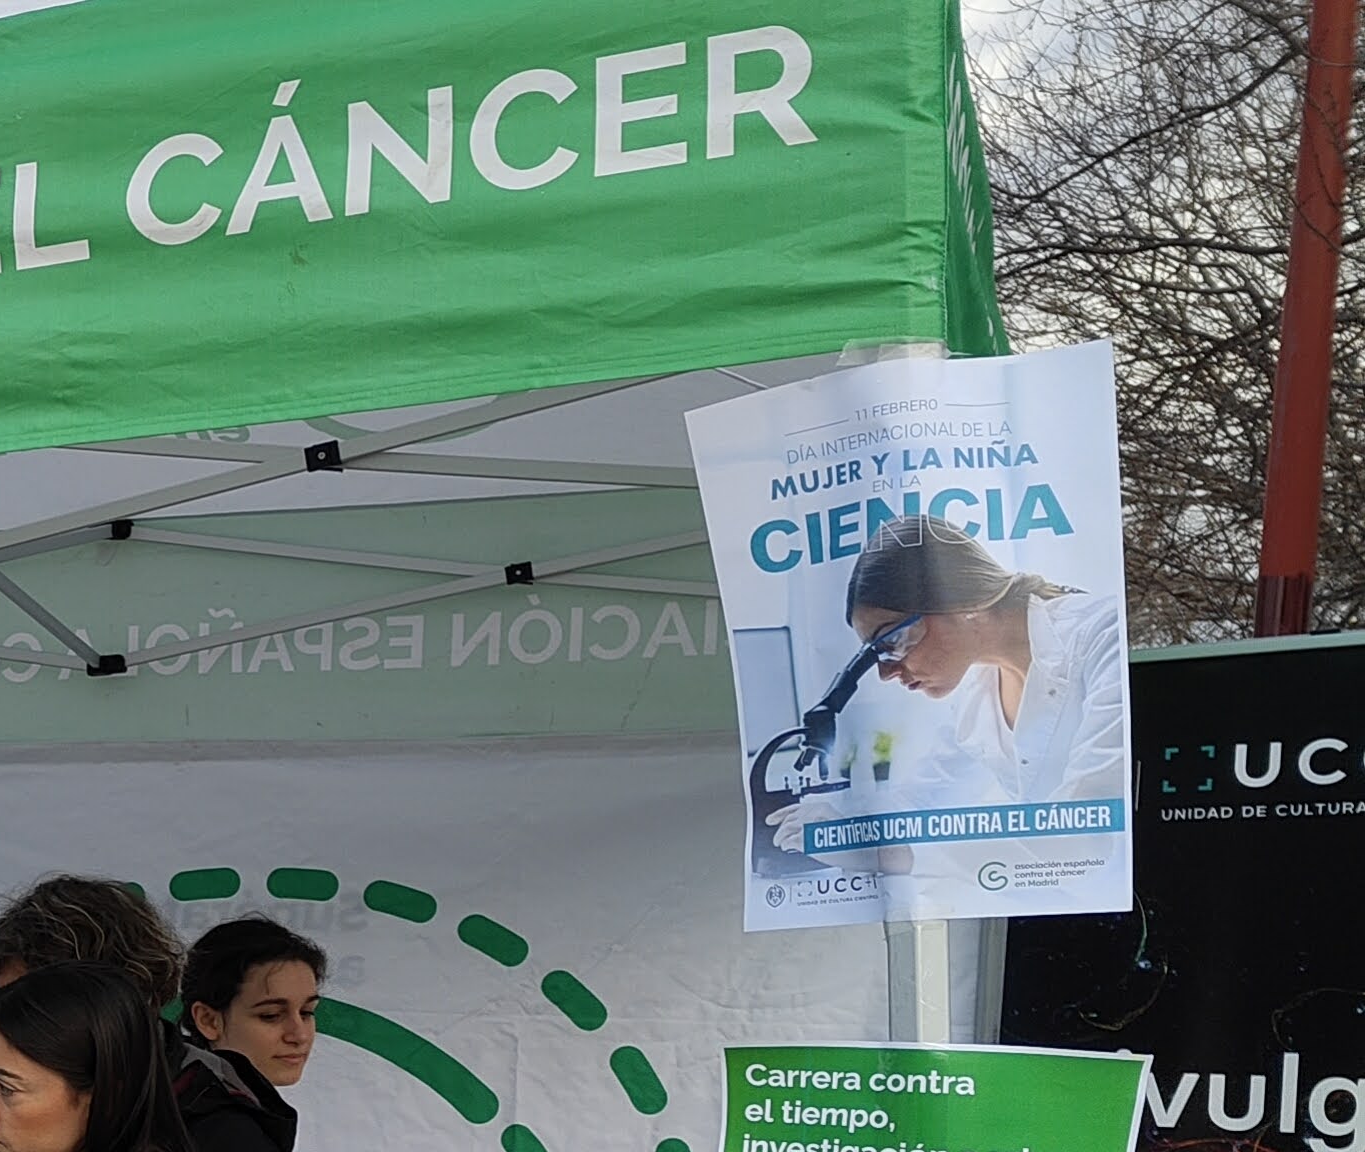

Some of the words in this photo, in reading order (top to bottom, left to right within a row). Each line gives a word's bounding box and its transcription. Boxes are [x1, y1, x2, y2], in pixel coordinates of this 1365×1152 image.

[126, 24, 820, 249] CÁNCER
[855, 409, 869, 422] 11
[873, 399, 938, 417] FEBRERO
[787, 444, 817, 464] DÍA
[821, 422, 958, 456] INTERNACIONAL
[962, 423, 983, 437] DE
[989, 421, 1012, 435] LA
[771, 460, 862, 500] MUJER
[871, 453, 890, 475] Y
[903, 443, 941, 471] LA
[954, 440, 1039, 468] NIÑA
[872, 478, 894, 493] EN
[899, 475, 921, 489] LA
[750, 483, 1074, 574] CIENCIA
[1234, 738, 1365, 788] UC
[814, 820, 880, 849] CIENTÍFICAS
[884, 816, 922, 840] UCM
[927, 811, 1003, 837] CONTRA
[1008, 809, 1030, 832] EL
[1034, 805, 1111, 830] CÁNCER
[1161, 806, 1233, 821] UNIDAD
[1241, 805, 1267, 818] DE
[1275, 802, 1365, 817] CULTURA
[1014, 861, 1063, 870] asociación
[1064, 859, 1105, 869] española
[1014, 870, 1043, 878] contra
[1045, 869, 1053, 877] el
[1055, 868, 1086, 877] cáncer
[1027, 878, 1059, 887] Madrid
[745, 1064, 862, 1091] Carrera
[868, 1068, 976, 1095] contra
[744, 1099, 773, 1124] el
[781, 1101, 896, 1133] tiempo,
